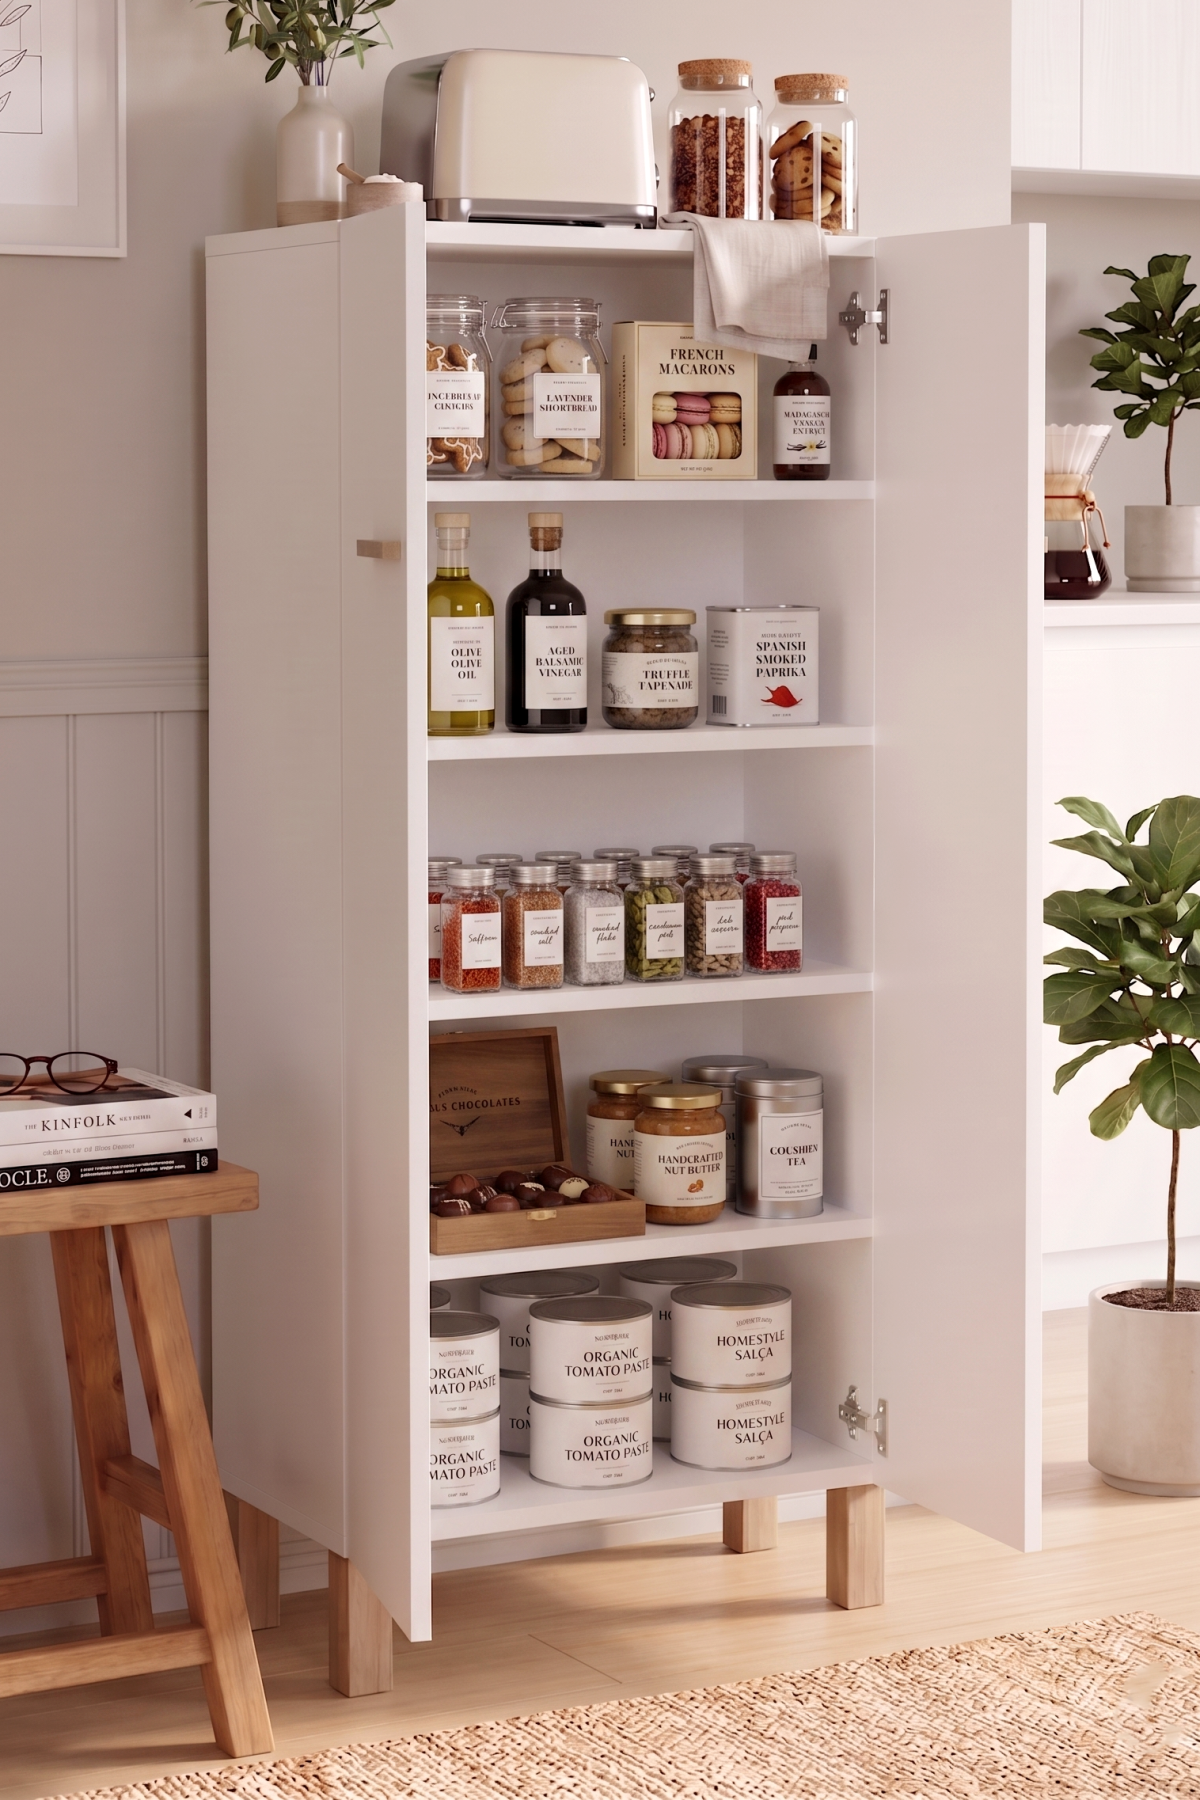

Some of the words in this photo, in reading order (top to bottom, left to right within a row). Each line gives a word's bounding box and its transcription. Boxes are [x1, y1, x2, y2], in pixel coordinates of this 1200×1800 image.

[670, 348, 724, 361] FRENCH
[659, 363, 735, 376] MACARONS
[546, 394, 593, 403] LAVENDER
[539, 404, 598, 413] SHORTBREAD
[451, 648, 482, 657] OLIVE
[547, 646, 575, 656] AGED
[756, 641, 807, 652] SPANISH
[451, 659, 482, 668] OLIVE
[535, 657, 584, 667] BALSAMIC
[756, 654, 807, 665] SMOKED
[457, 670, 477, 679] OIL
[538, 668, 582, 677] VINEGAR
[642, 669, 691, 680] TRUFFLE
[756, 667, 807, 678] PAPRIKA
[638, 680, 693, 691] TAPENADE
[451, 1097, 521, 1111] CHOCOLATES
[41, 1114, 117, 1132] KINFOLK
[658, 1151, 724, 1164] HANDCRAFTED
[787, 1157, 806, 1167] TEA
[664, 1166, 686, 1175] NUT
[687, 1163, 721, 1175] BUTTER
[717, 1329, 785, 1347] HOMESTYLE
[583, 1347, 639, 1363] ORGANIC
[735, 1347, 774, 1361] SALÇA
[564, 1364, 621, 1378] TOMATO
[623, 1358, 650, 1375] PASTE
[468, 1374, 497, 1393] PASTE
[717, 1412, 785, 1430] HOMESTYLE
[583, 1431, 639, 1447] ORGANIC
[735, 1430, 774, 1445] SALÇA
[564, 1449, 621, 1462] TOMATO
[623, 1441, 649, 1459] PASTE
[469, 1459, 497, 1478] PASTE
